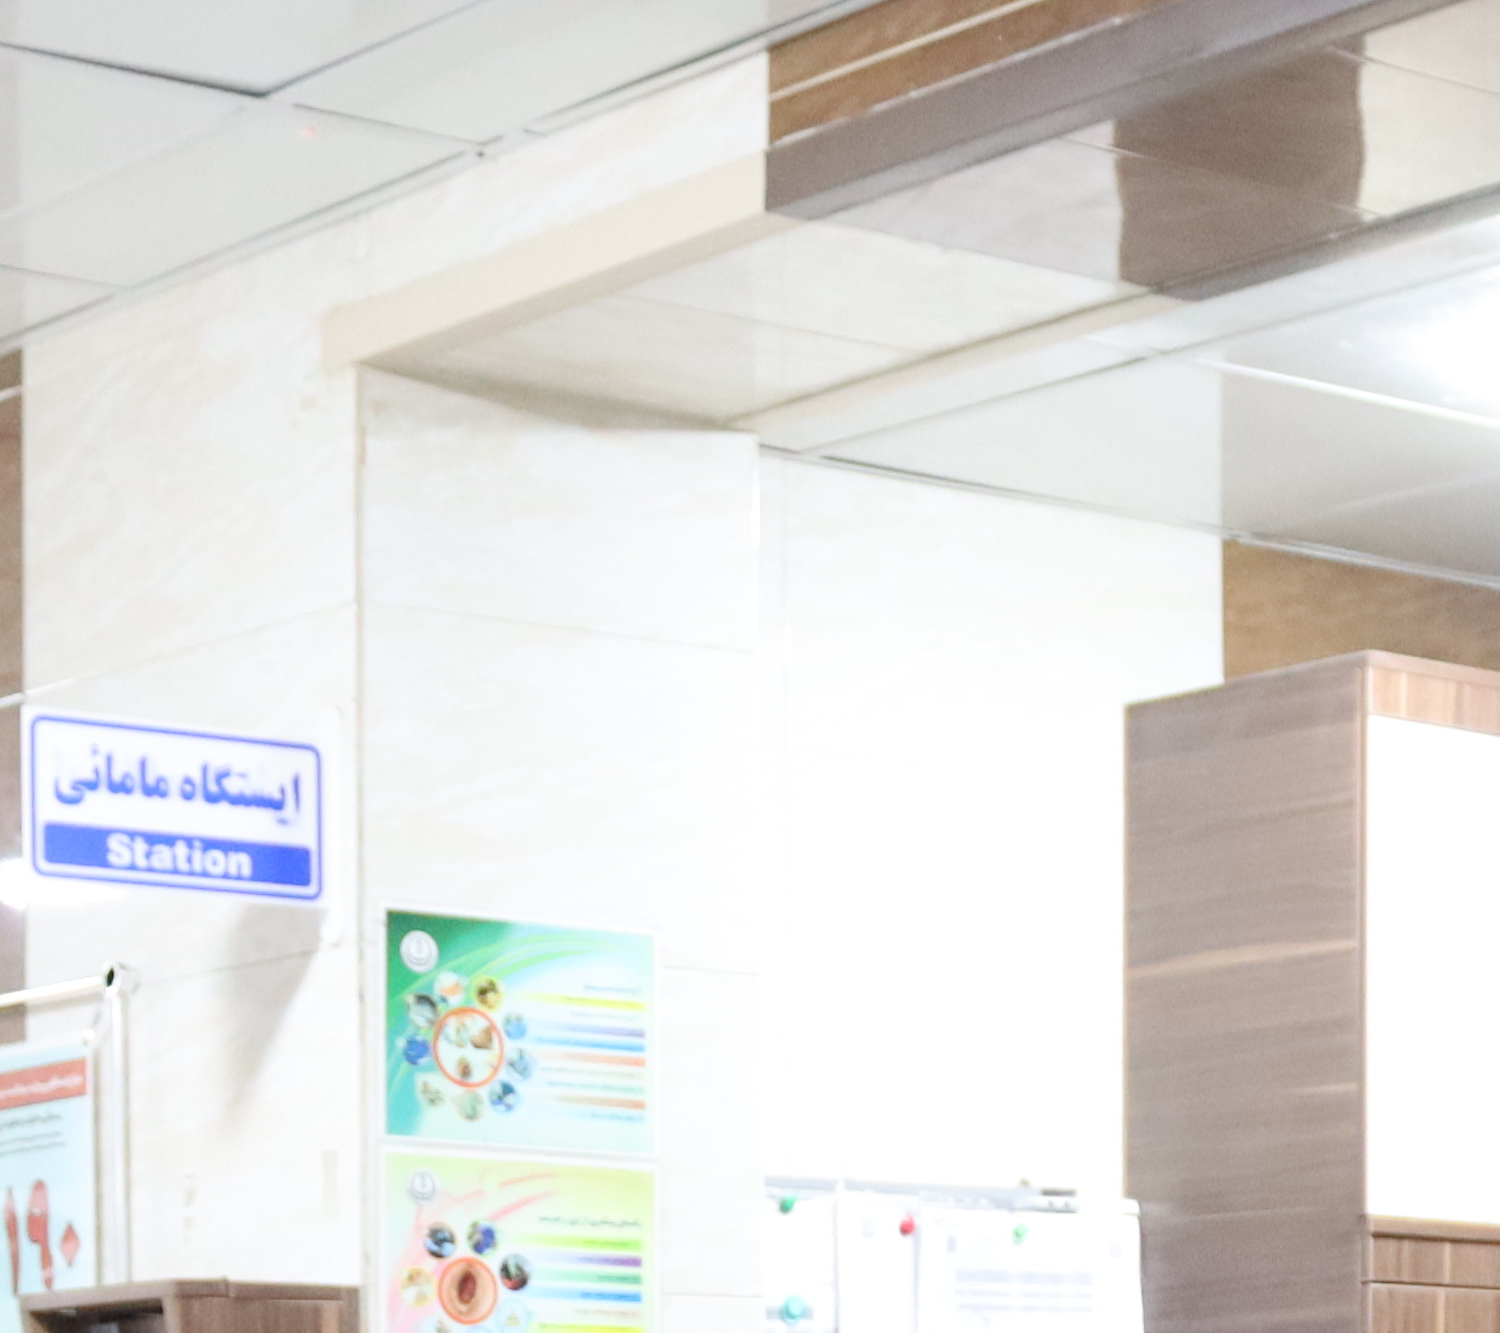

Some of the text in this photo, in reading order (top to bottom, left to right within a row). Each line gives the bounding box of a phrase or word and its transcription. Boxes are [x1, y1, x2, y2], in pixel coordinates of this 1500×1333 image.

[53, 742, 302, 826] ایستگاه مامانی
[106, 833, 253, 879] Station
